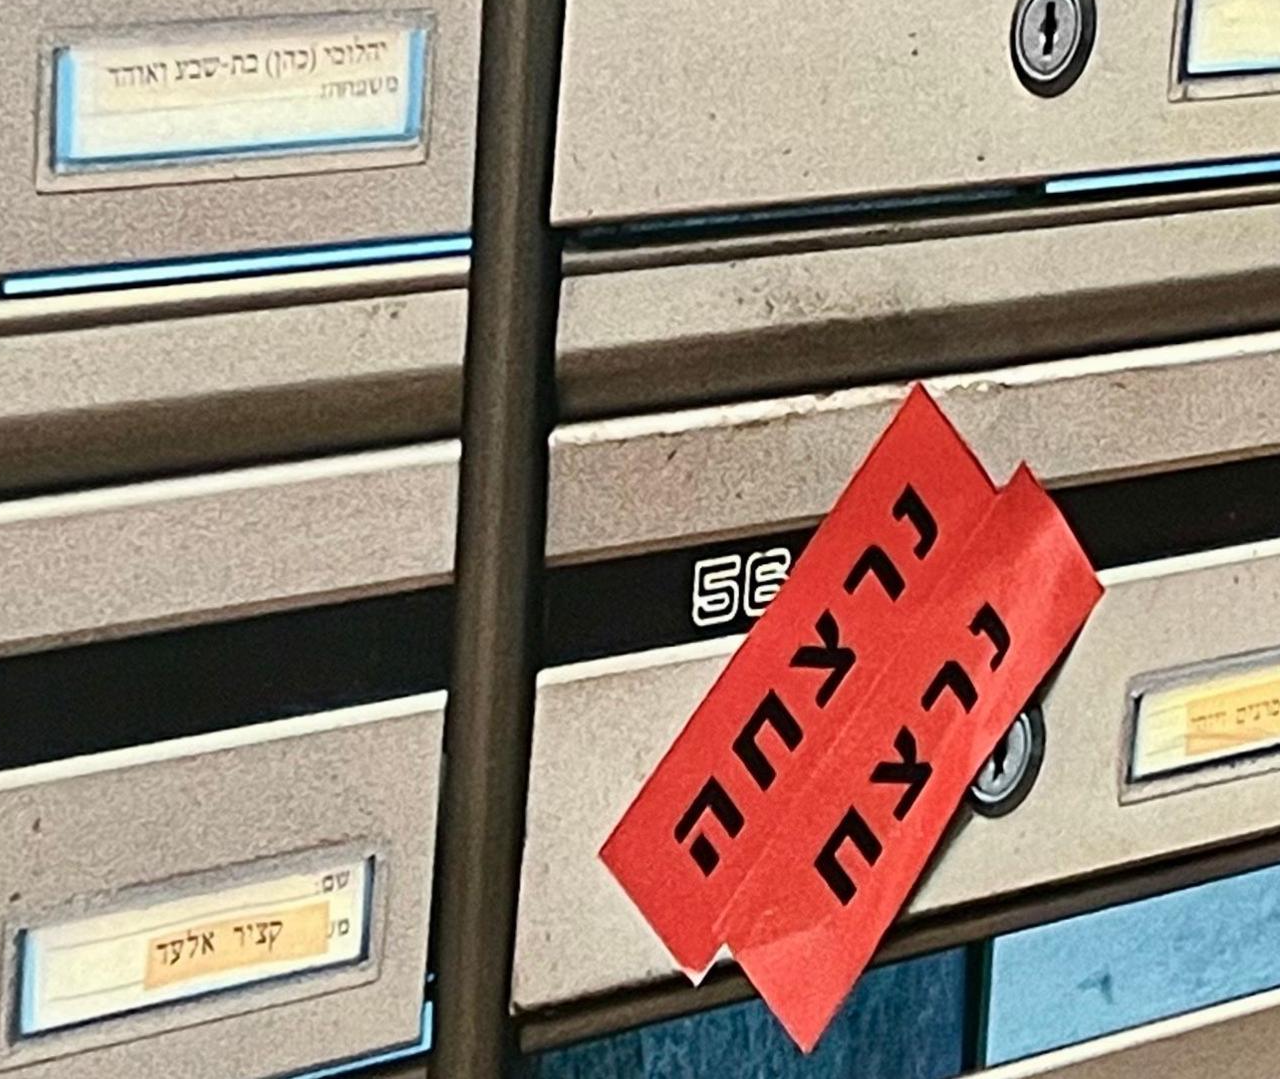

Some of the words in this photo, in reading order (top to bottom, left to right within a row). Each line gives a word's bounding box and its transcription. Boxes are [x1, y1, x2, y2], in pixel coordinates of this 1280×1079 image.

[265, 46, 318, 80] (כהן)
[692, 548, 790, 627] 56
[675, 483, 938, 877] נרצחה
[814, 602, 1012, 906] נרצח
[157, 930, 217, 966] אלעד
[233, 920, 283, 952] קציר
